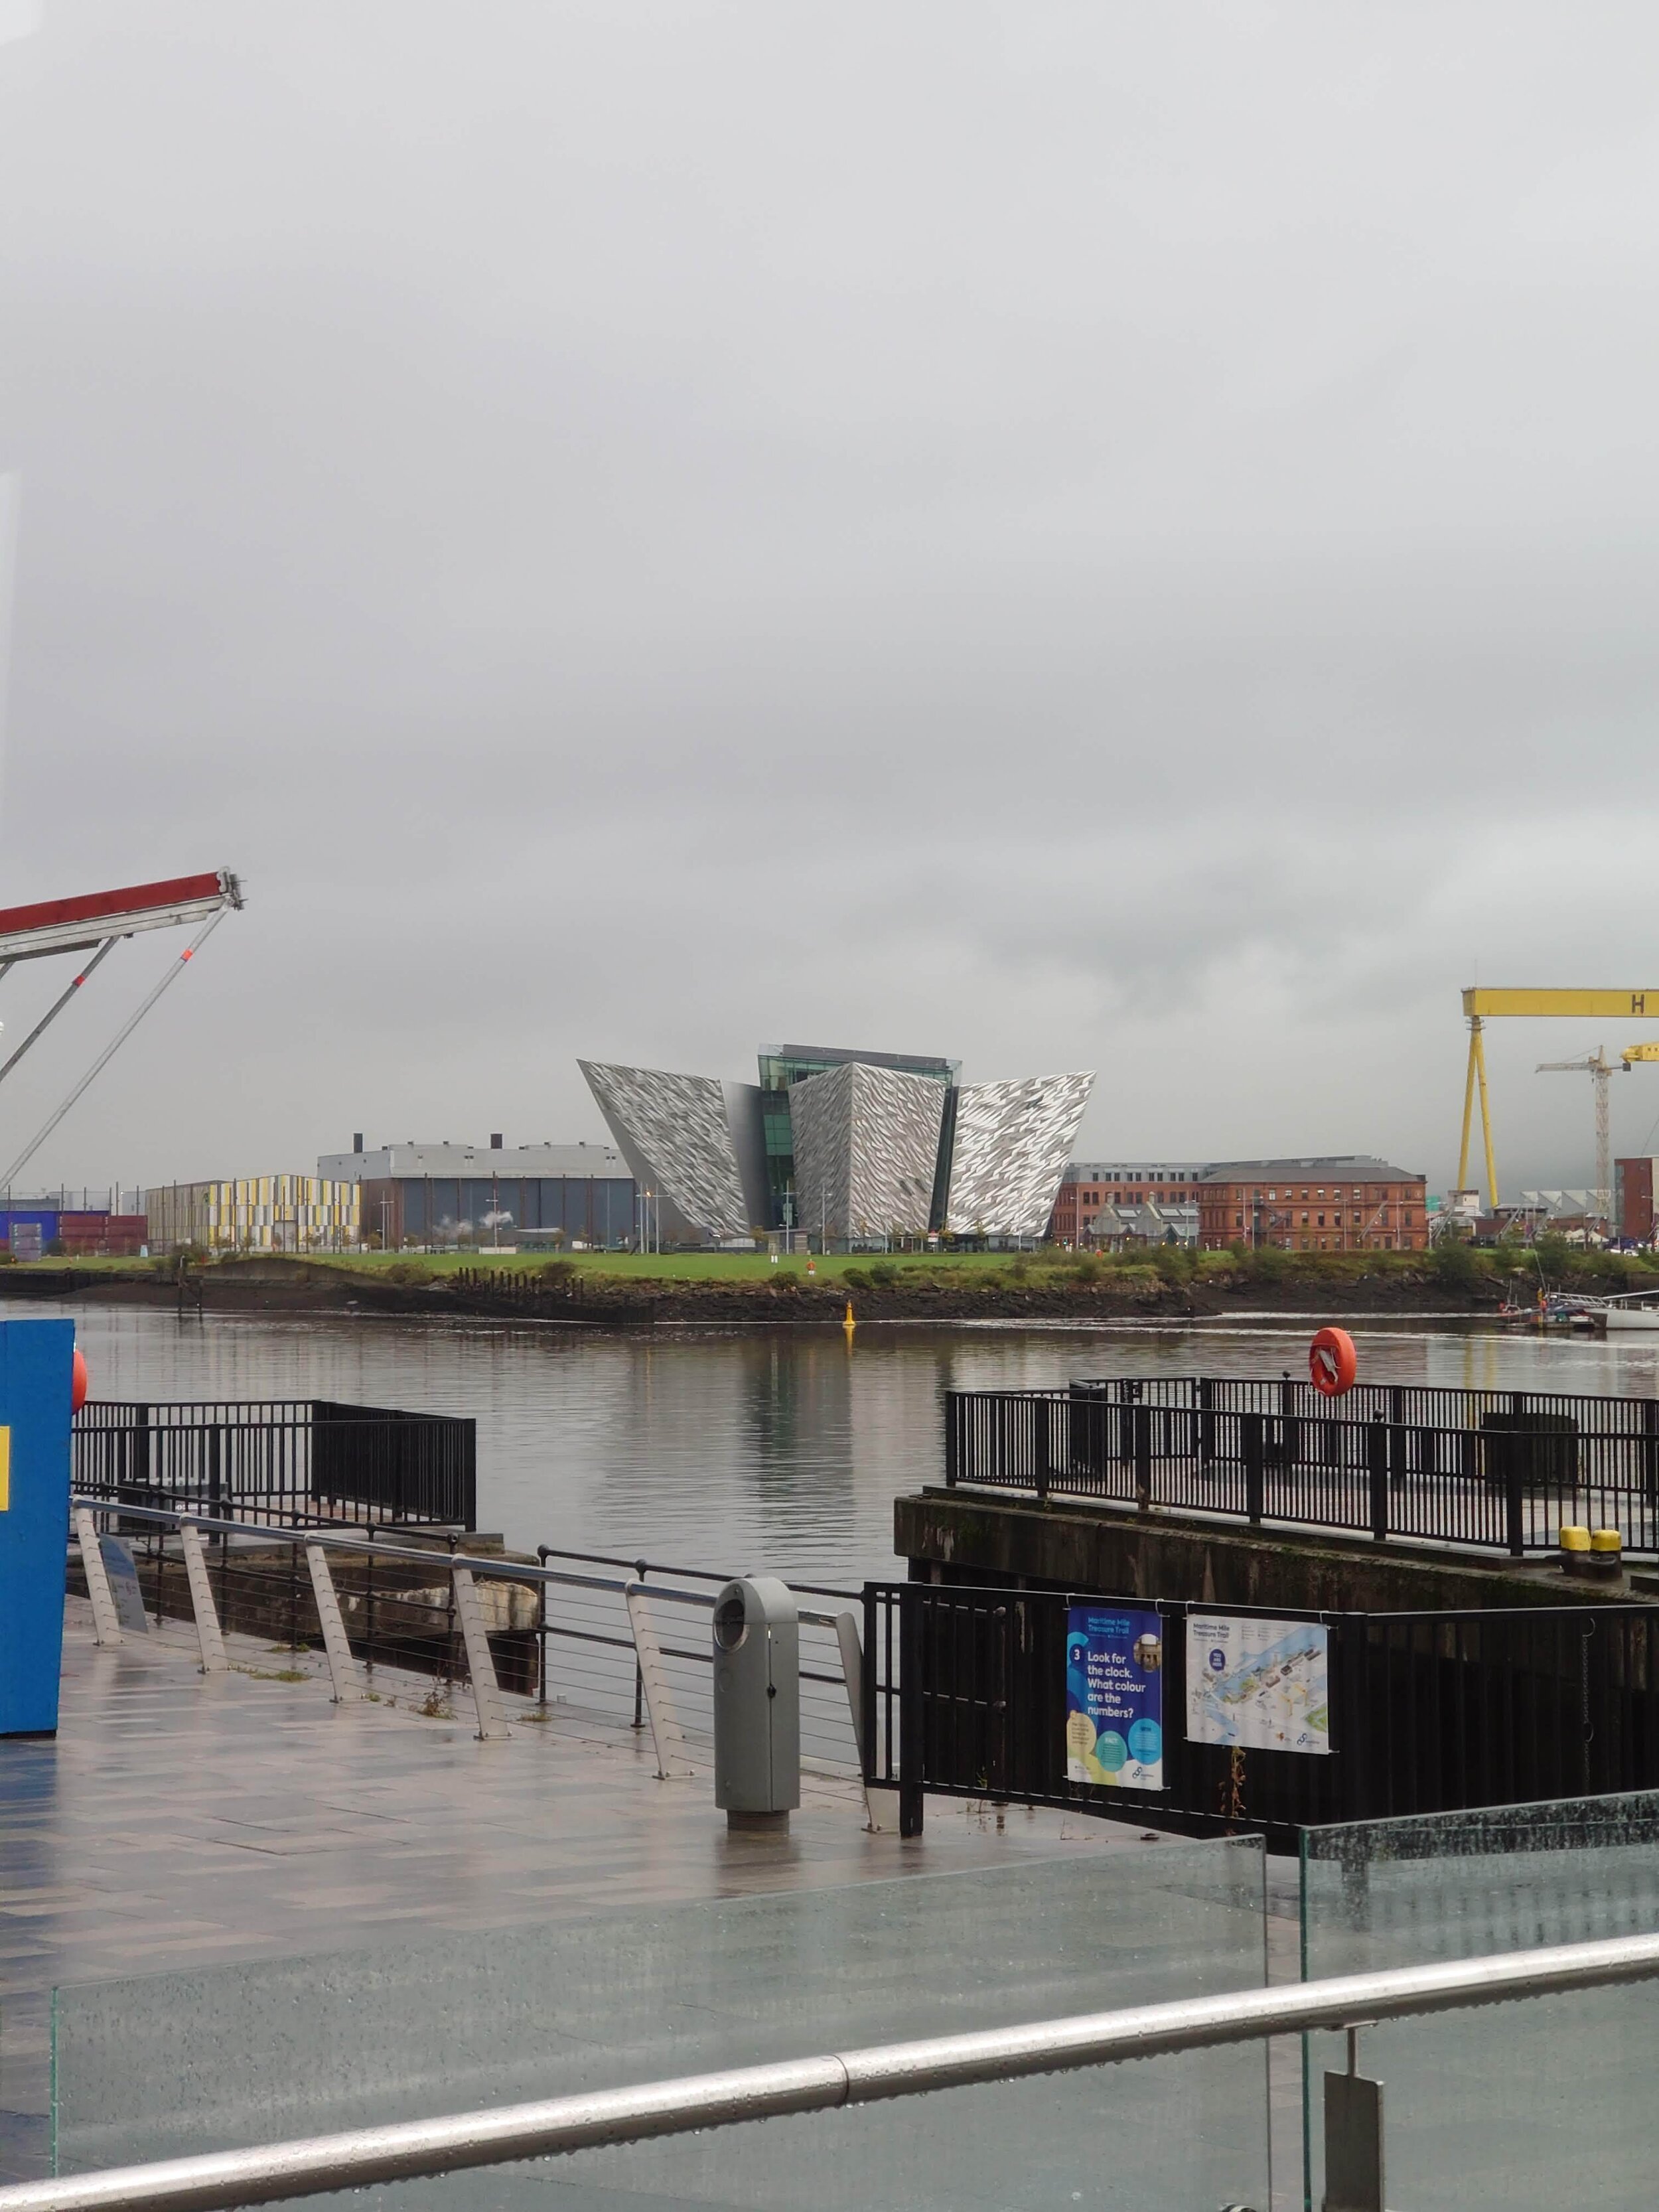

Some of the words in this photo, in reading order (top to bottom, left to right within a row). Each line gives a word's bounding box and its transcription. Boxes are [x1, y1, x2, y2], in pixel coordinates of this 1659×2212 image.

[1632, 994, 1644, 1014] H
[1088, 1617, 1115, 1625] Maritime
[1074, 1649, 1080, 1660] 3
[1088, 1651, 1110, 1663] Look
[1112, 1653, 1126, 1664] for
[1087, 1664, 1103, 1676] the
[1105, 1667, 1133, 1678] clock.
[1088, 1678, 1114, 1690] What
[1115, 1681, 1146, 1692] colour
[1087, 1693, 1103, 1703] are
[1105, 1693, 1121, 1704] the
[1087, 1706, 1133, 1718] numbers?
